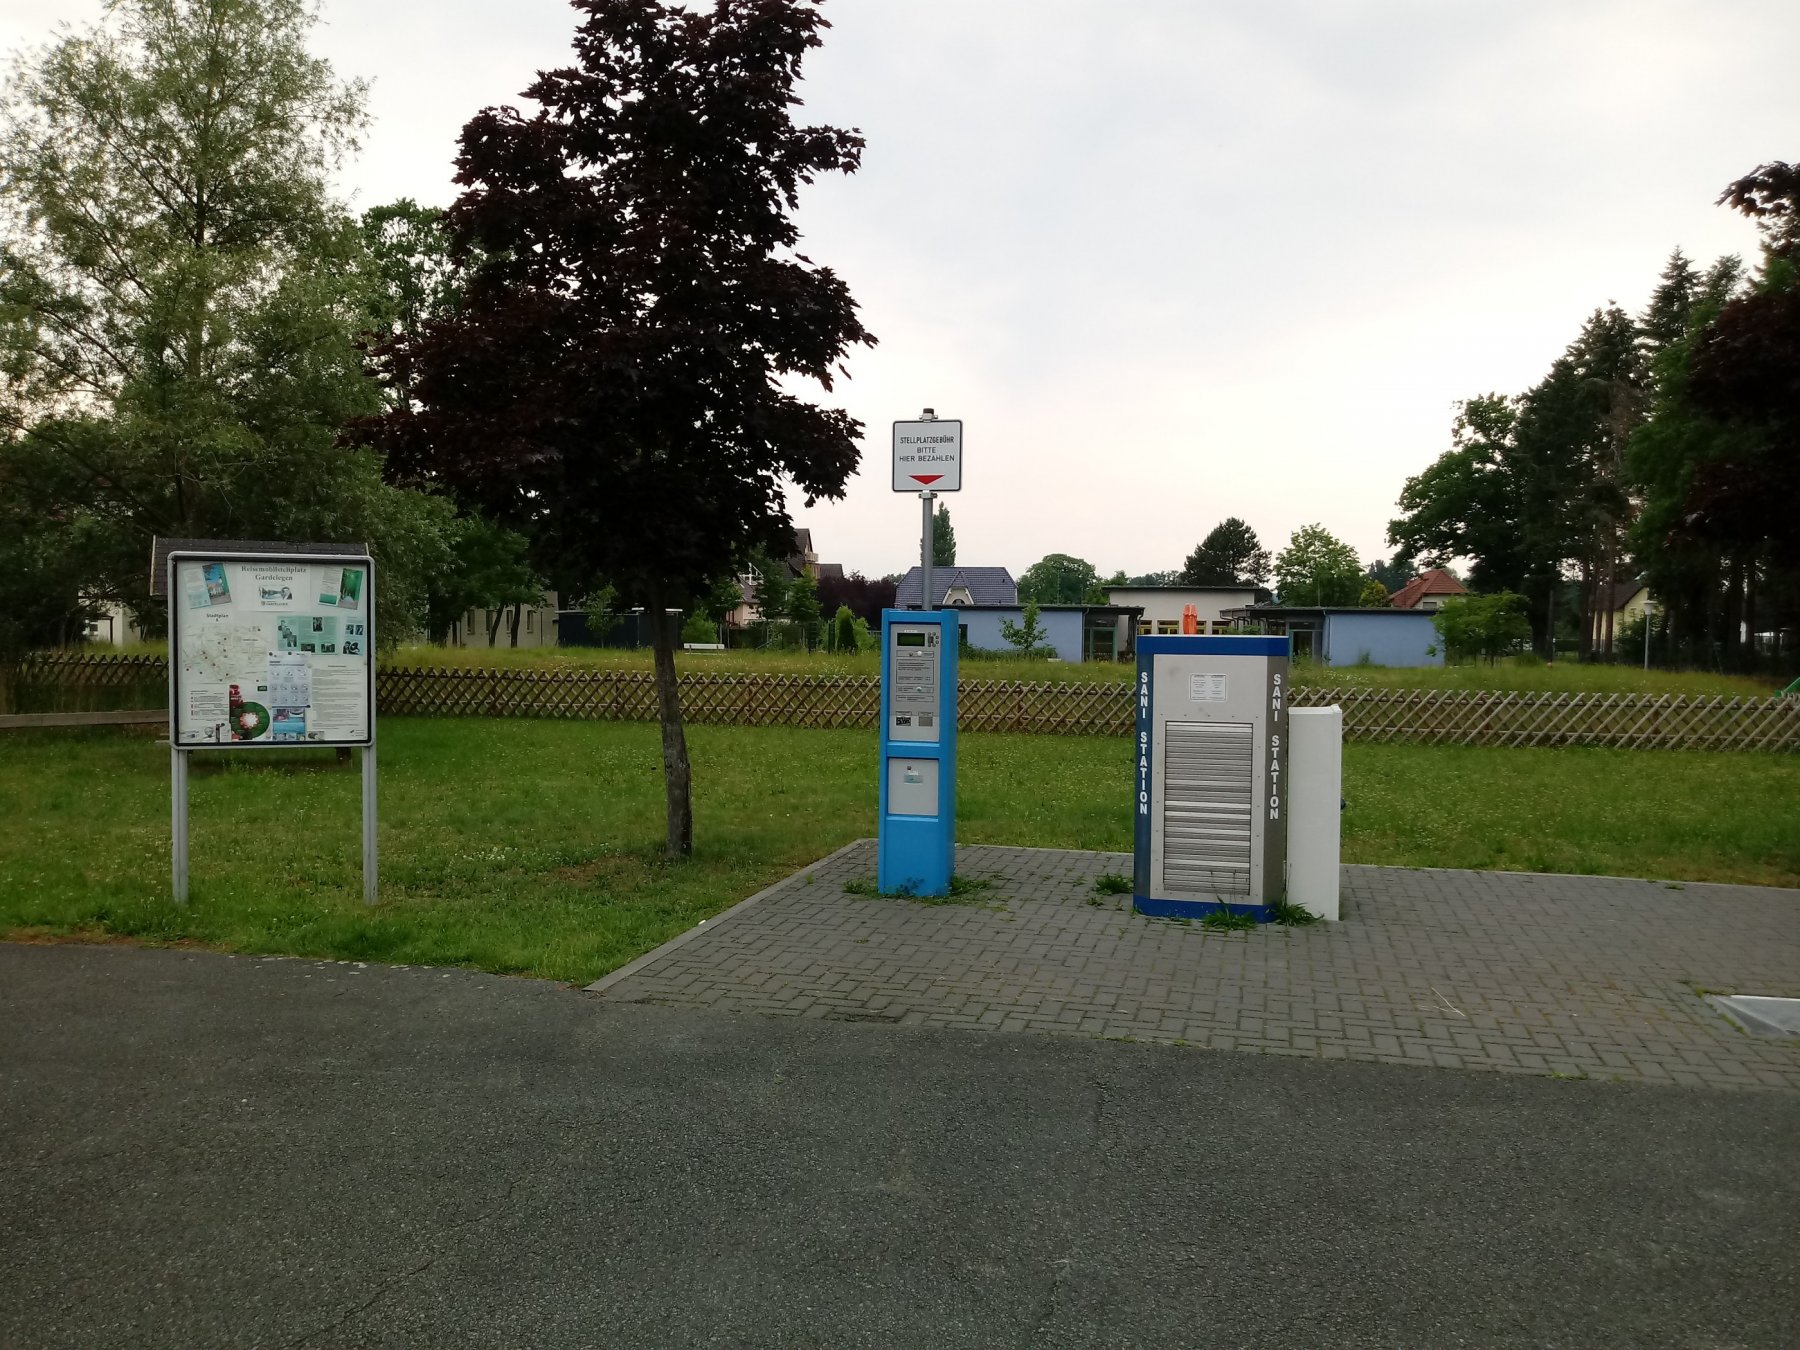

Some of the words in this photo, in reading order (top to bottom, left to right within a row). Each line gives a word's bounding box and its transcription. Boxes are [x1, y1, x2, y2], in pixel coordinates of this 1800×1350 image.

[900, 435, 954, 444] STELLPLATZGEBÜHR
[918, 454, 955, 462] BEZAHLEN
[1140, 672, 1148, 719] SANI
[1272, 674, 1281, 722] SANI
[1139, 732, 1148, 814] STATION
[1270, 735, 1279, 819] STATION
